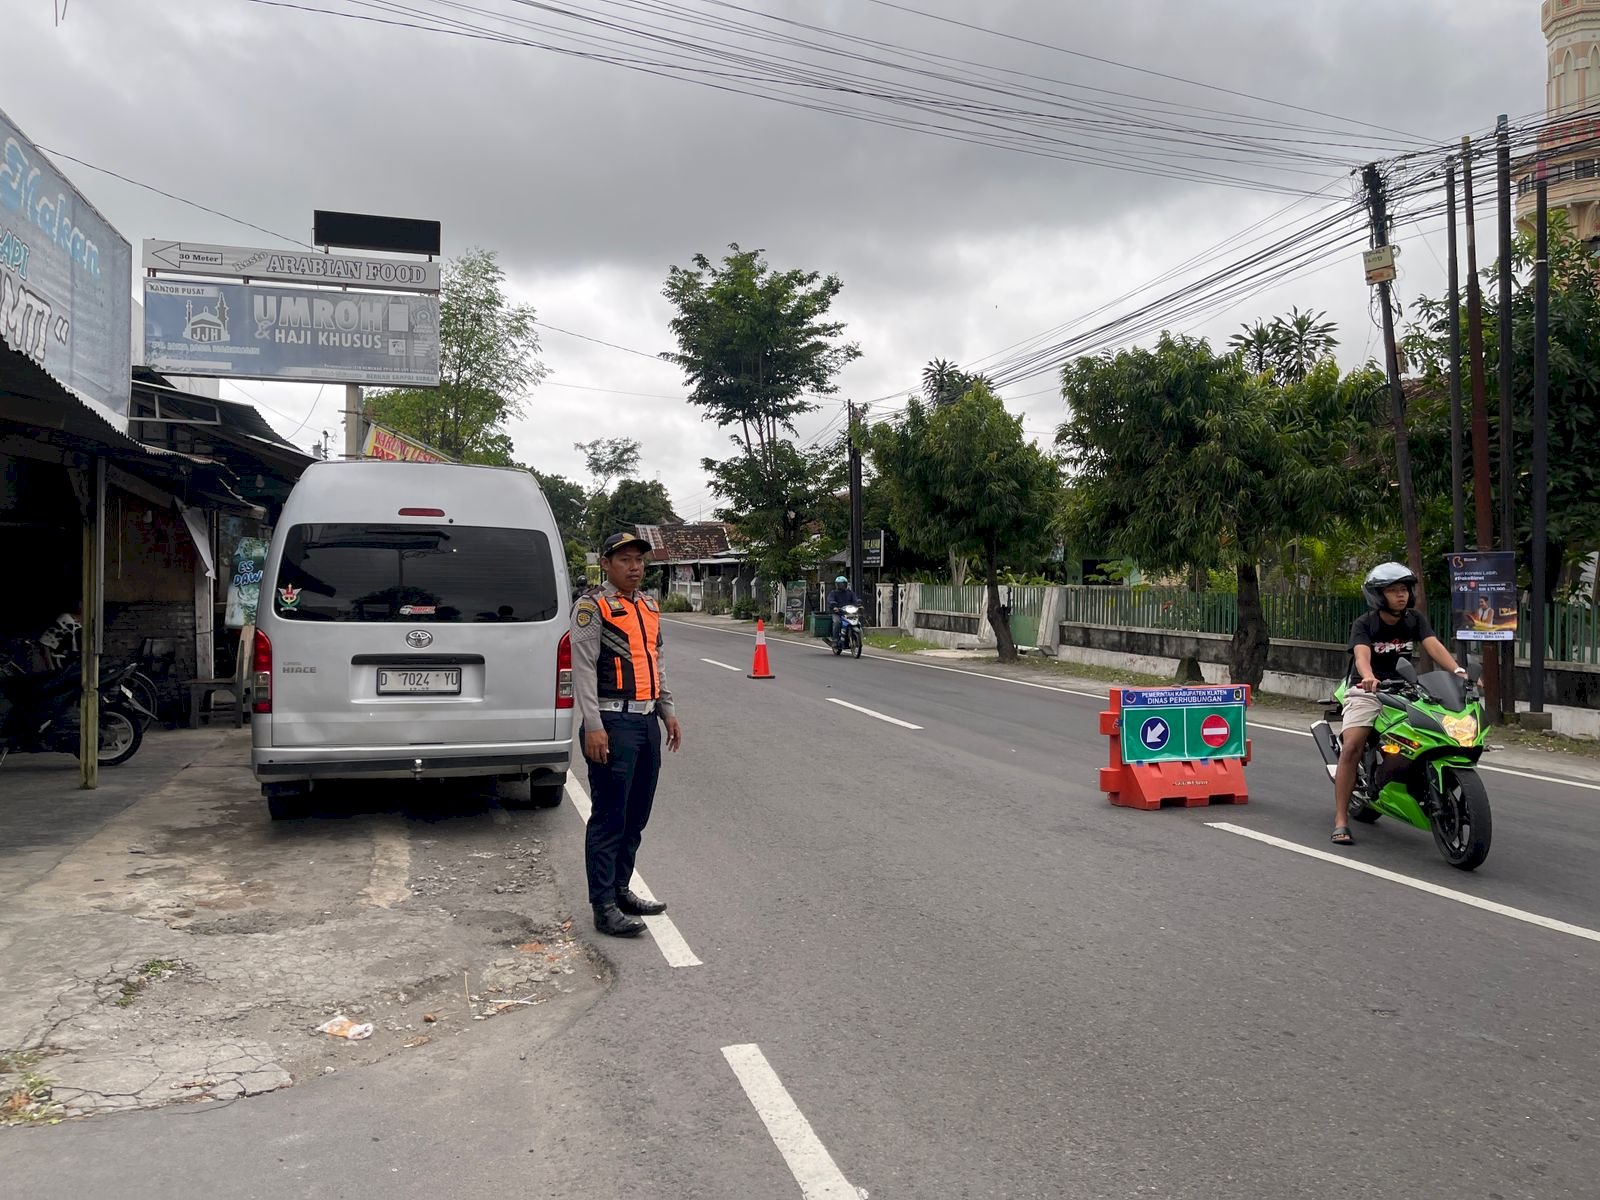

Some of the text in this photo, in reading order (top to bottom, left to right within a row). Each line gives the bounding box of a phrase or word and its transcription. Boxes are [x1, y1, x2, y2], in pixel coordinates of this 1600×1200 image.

[0, 229, 29, 280] API
[192, 254, 219, 262] Meter
[232, 251, 269, 273] Resto
[266, 254, 427, 284] ARABIAN FOOD
[150, 283, 205, 296] KANTOR PUSAT
[253, 294, 383, 333] UMROH
[192, 325, 220, 342] JJH
[275, 328, 311, 345] HAJI
[318, 331, 382, 349] KHUSUS
[239, 560, 254, 573] ES
[380, 672, 458, 686] D 7024 YU
[1147, 695, 1222, 705] DINAS PERHUBUNGAN
